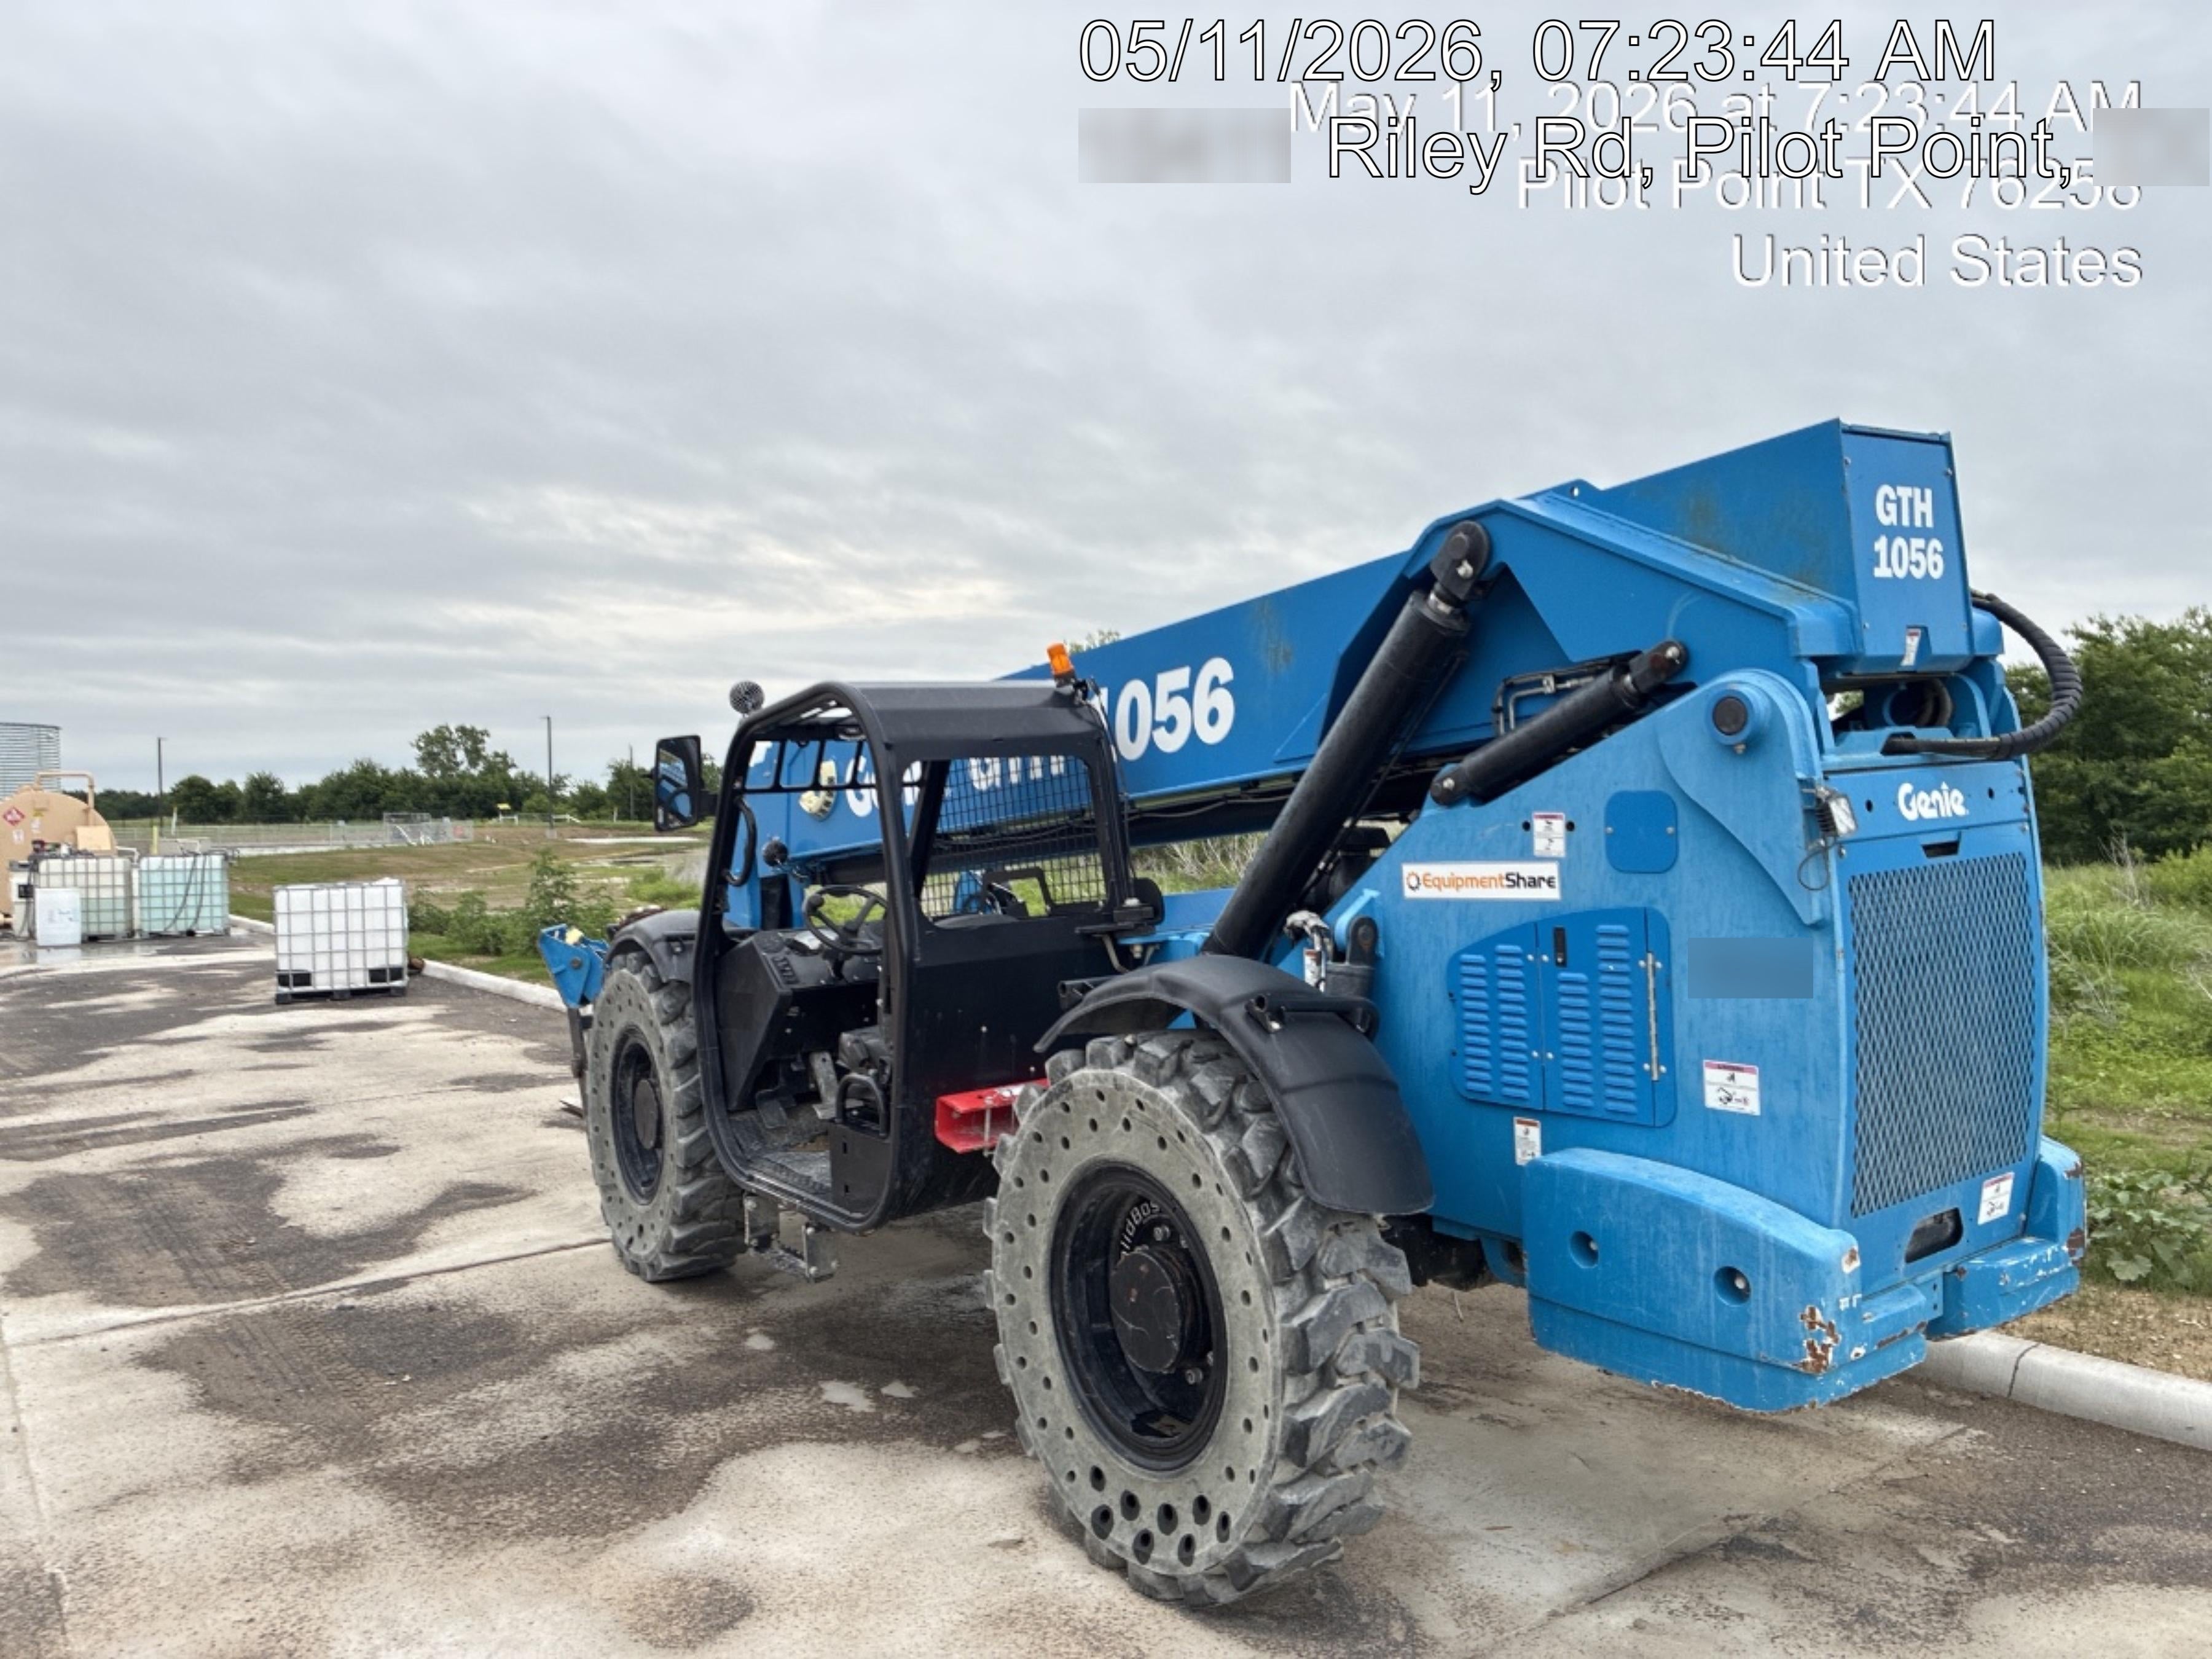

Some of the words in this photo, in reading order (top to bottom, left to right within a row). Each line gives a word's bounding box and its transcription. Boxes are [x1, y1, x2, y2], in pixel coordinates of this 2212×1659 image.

[1875, 484, 1934, 528] GTH
[1873, 534, 1945, 579] 1056
[1898, 781, 1969, 821] Genie
[1422, 871, 1556, 892] EquipmentShare
